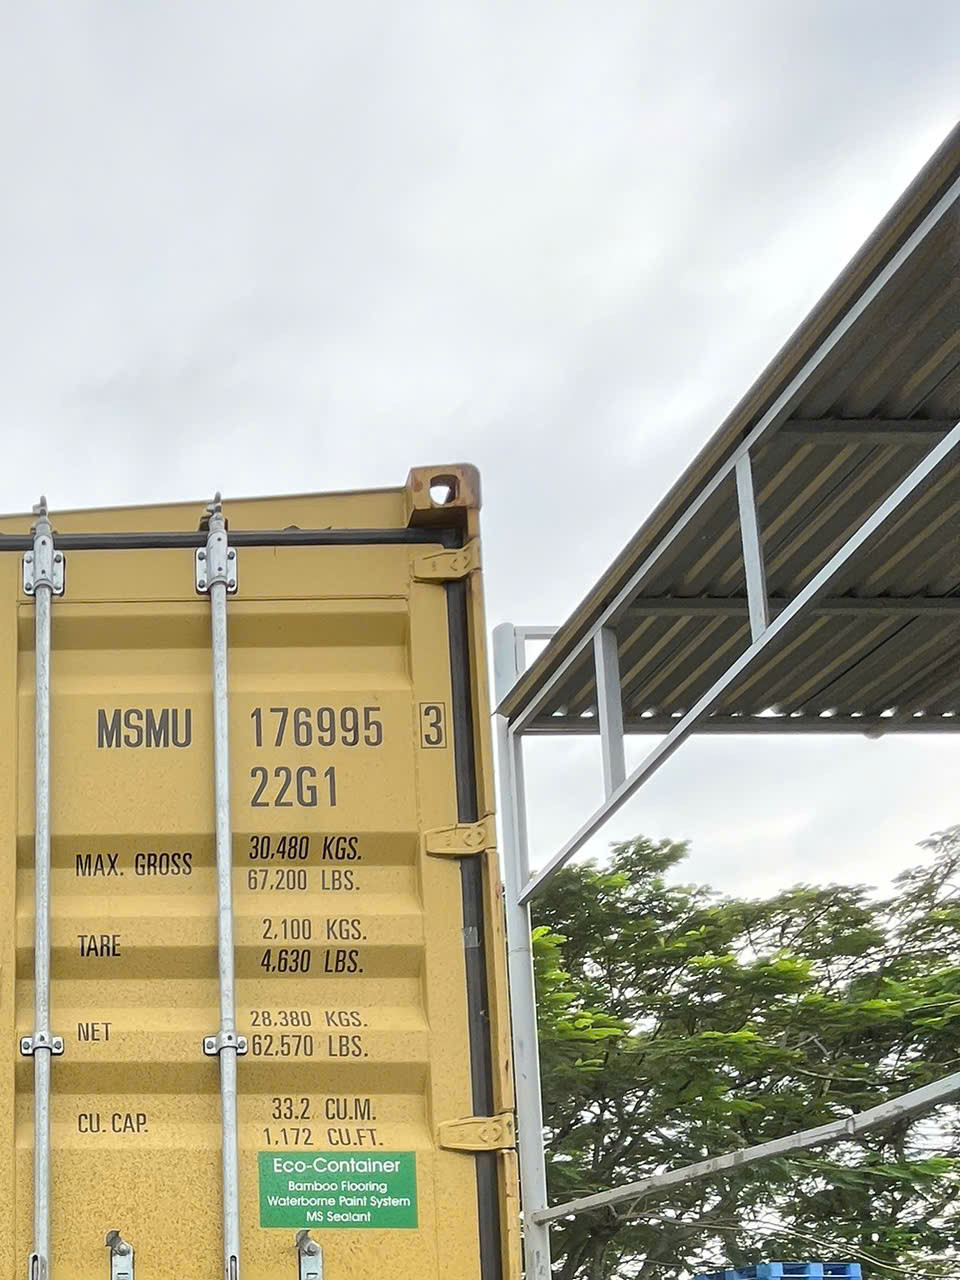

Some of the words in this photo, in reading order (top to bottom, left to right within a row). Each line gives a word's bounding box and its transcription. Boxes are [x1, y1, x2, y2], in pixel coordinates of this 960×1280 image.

[97, 708, 192, 749] MSMU
[249, 706, 383, 748] 176995
[423, 705, 444, 747] 3
[250, 766, 337, 807] 22G1
[249, 836, 309, 861] 30,480
[322, 836, 362, 861] KGS.
[75, 854, 124, 877] MAX.
[135, 852, 192, 876] GROSS
[248, 869, 307, 891] 67,200
[321, 869, 361, 891] LBS.
[262, 918, 312, 941] 2,100
[326, 918, 367, 941] KGS.
[77, 934, 121, 958] TARE
[260, 949, 311, 975] 4,630
[323, 949, 364, 974] LBS.
[250, 1010, 311, 1028] 28,380
[326, 1011, 368, 1028] KGS.
[77, 1022, 112, 1042] NET
[252, 1034, 313, 1058] 62,570
[327, 1035, 369, 1058] LBS.
[272, 1098, 310, 1121] 33.2
[325, 1098, 376, 1121] CU.M.
[78, 1113, 107, 1133] CU.
[112, 1112, 149, 1133] CAP.
[263, 1127, 313, 1147] 1,172
[327, 1127, 384, 1147] CU.FT.
[272, 1157, 400, 1173] Eco-Container
[288, 1181, 338, 1192] Bamboo
[341, 1180, 387, 1194] Flooring
[267, 1195, 336, 1207] Waterborne
[339, 1195, 367, 1207] Paint
[370, 1195, 410, 1209] System
[306, 1211, 323, 1222] MS
[326, 1210, 371, 1222] Sealant
